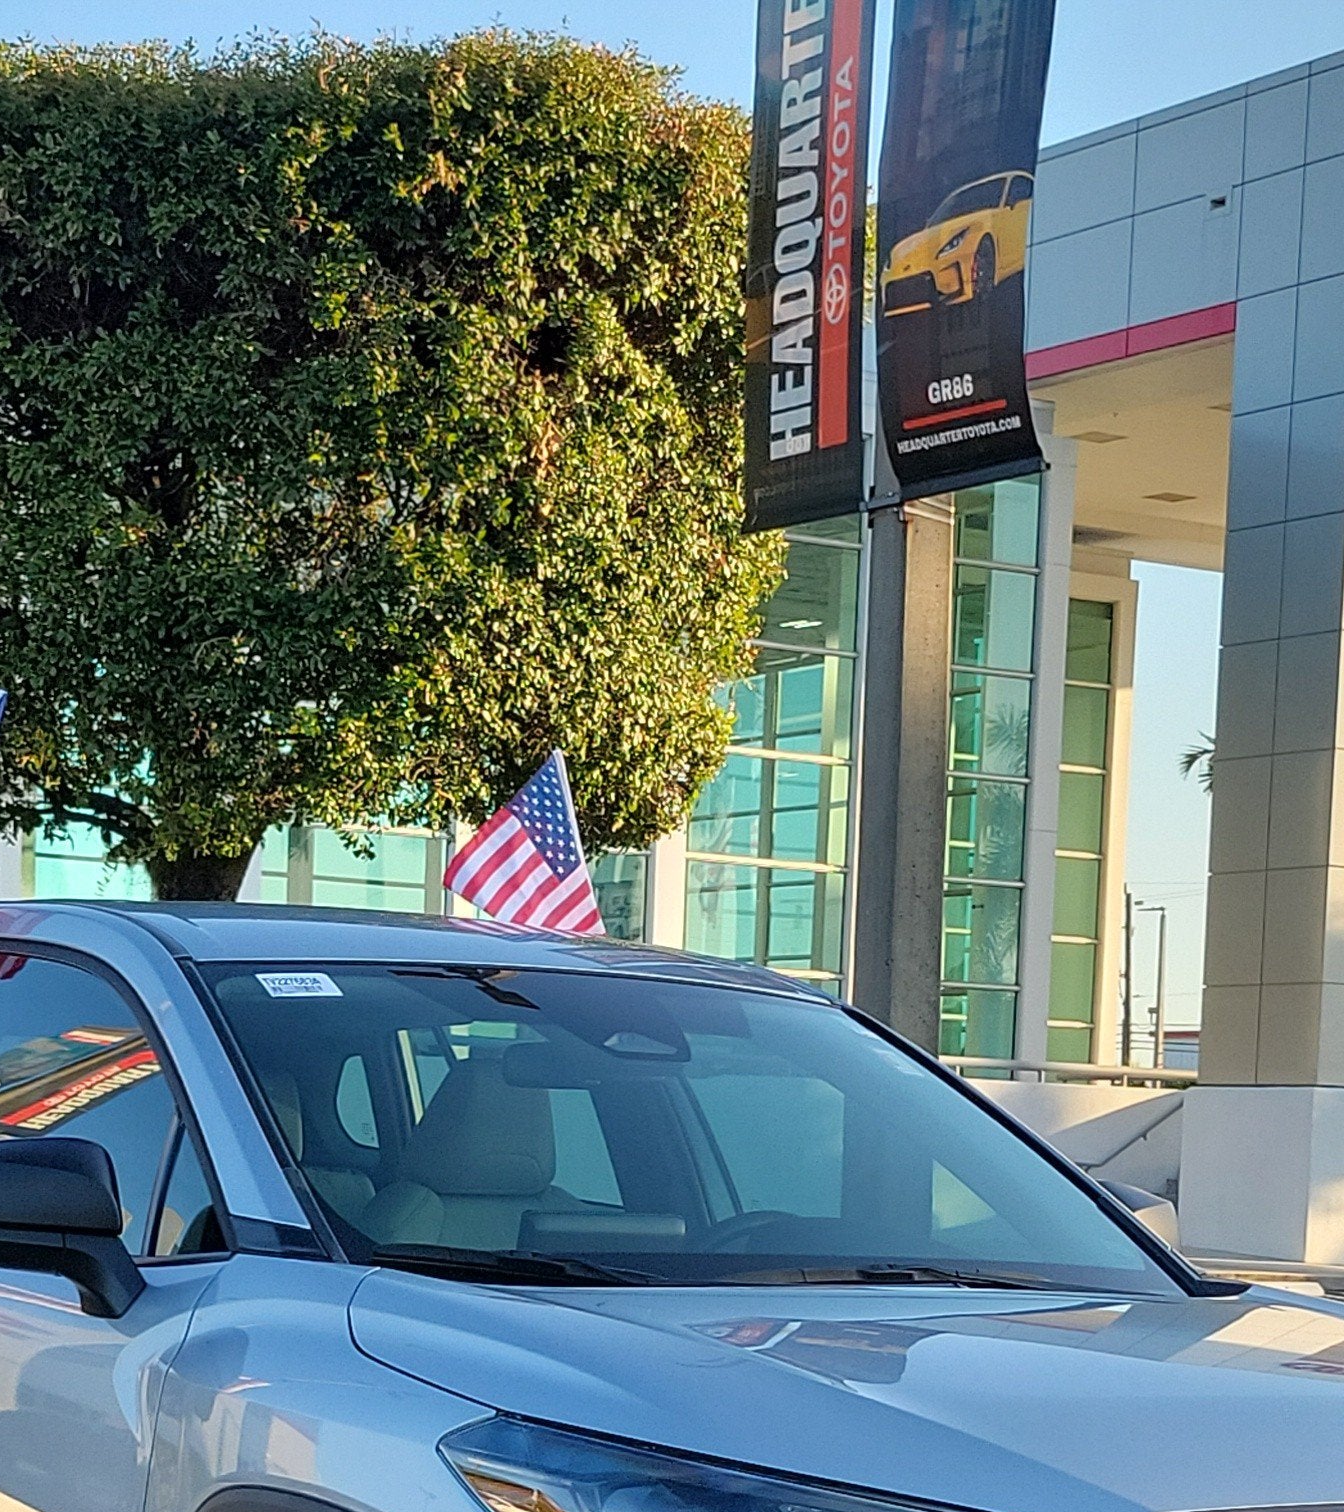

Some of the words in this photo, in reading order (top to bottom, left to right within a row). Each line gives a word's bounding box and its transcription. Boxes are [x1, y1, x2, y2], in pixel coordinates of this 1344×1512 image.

[828, 54, 854, 260] TOYOTA
[927, 373, 974, 404] GR86
[896, 415, 1022, 455] HEADQUARTERTOYOTA.COM
